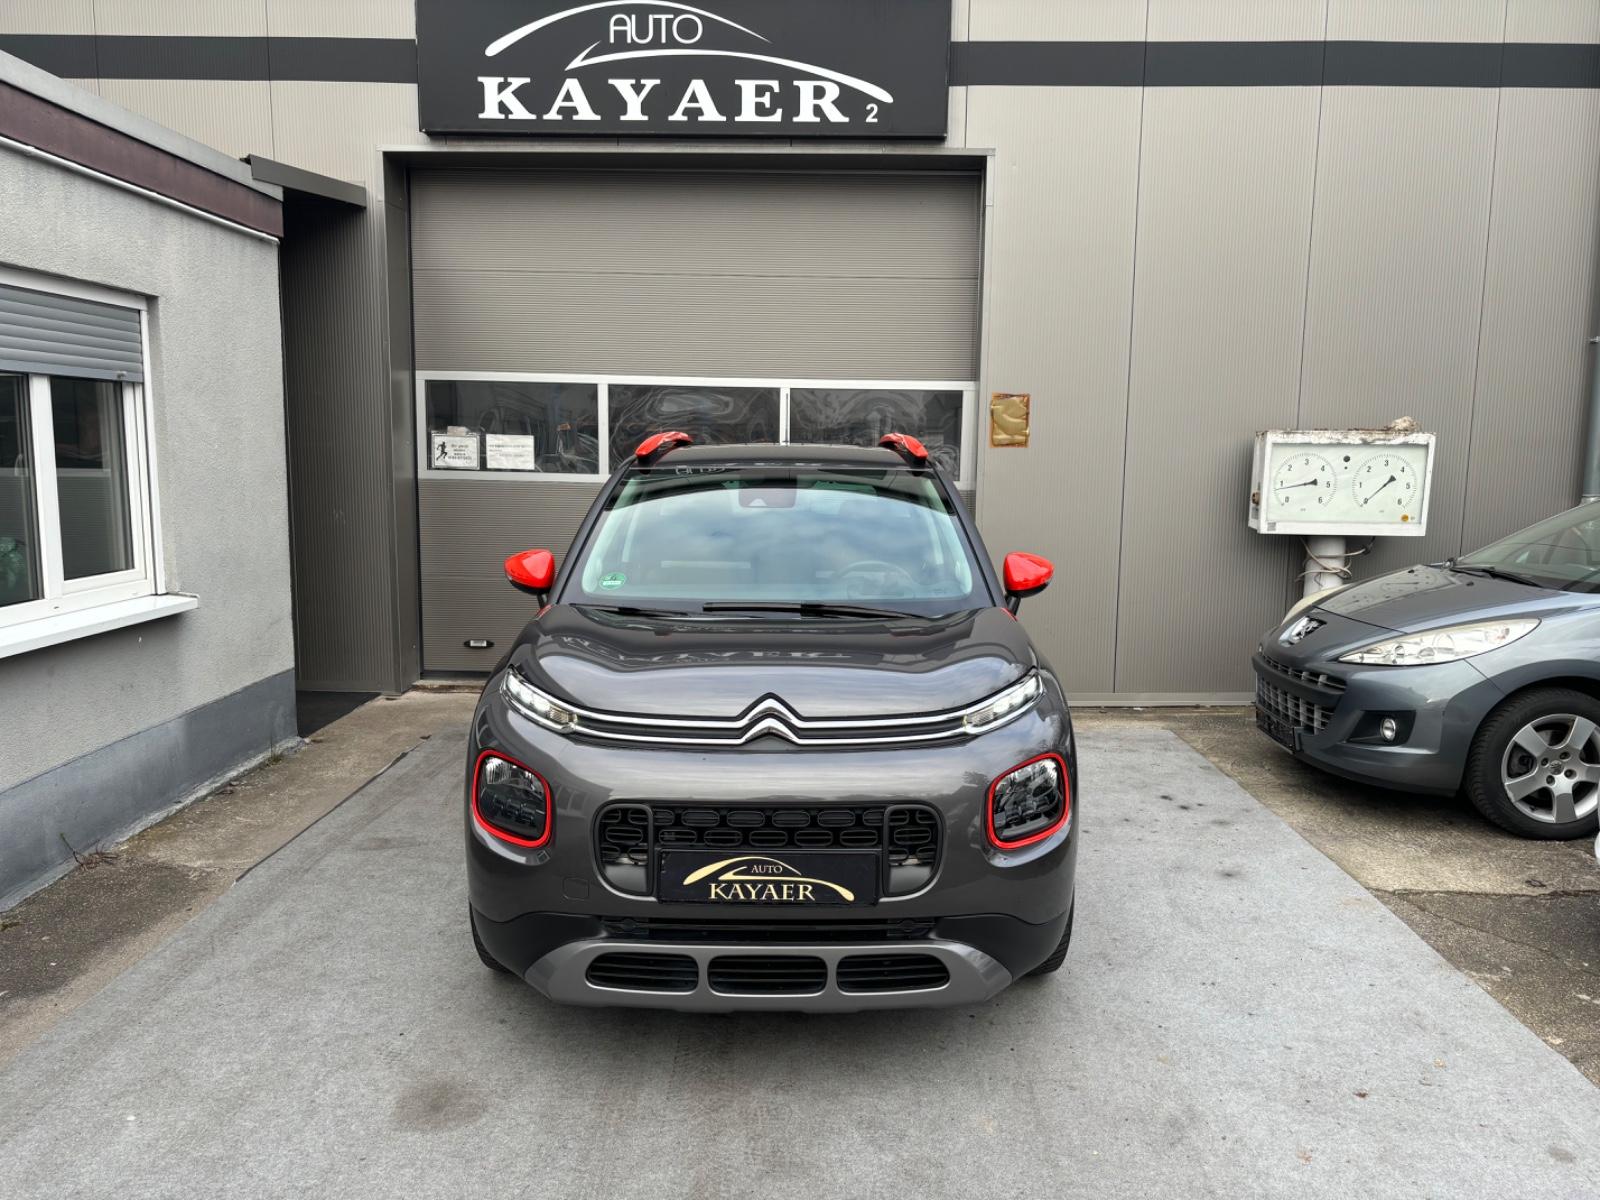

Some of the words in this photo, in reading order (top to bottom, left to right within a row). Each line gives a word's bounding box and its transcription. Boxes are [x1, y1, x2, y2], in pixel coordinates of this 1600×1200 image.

[609, 14, 703, 44] AUTO
[477, 76, 850, 123] KAYAER
[865, 103, 879, 124] 2
[751, 864, 783, 874] AUTO
[708, 882, 815, 901] KAYAER
